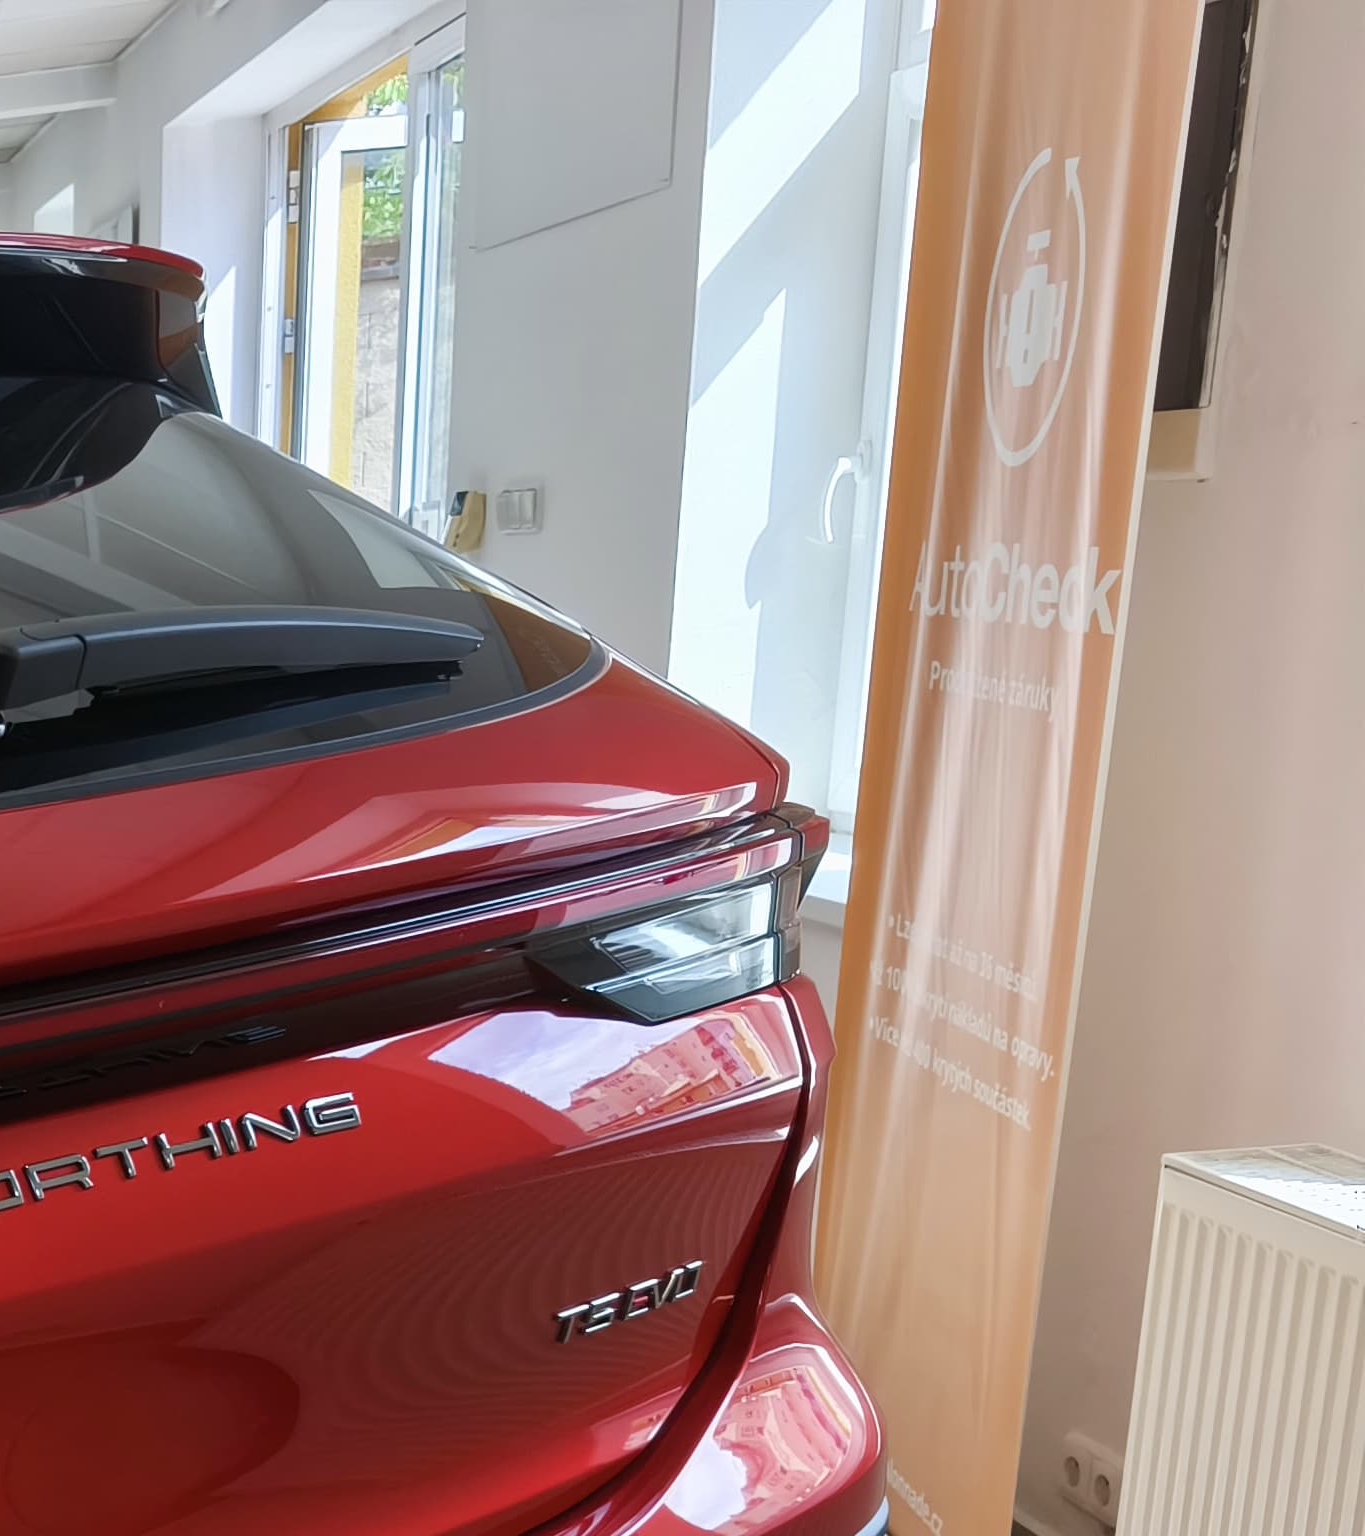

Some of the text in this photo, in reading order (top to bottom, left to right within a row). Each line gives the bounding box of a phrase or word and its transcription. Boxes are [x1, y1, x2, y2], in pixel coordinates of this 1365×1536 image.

[908, 540, 1122, 635] AutoCheck
[554, 1260, 703, 1344] T5 EVO
